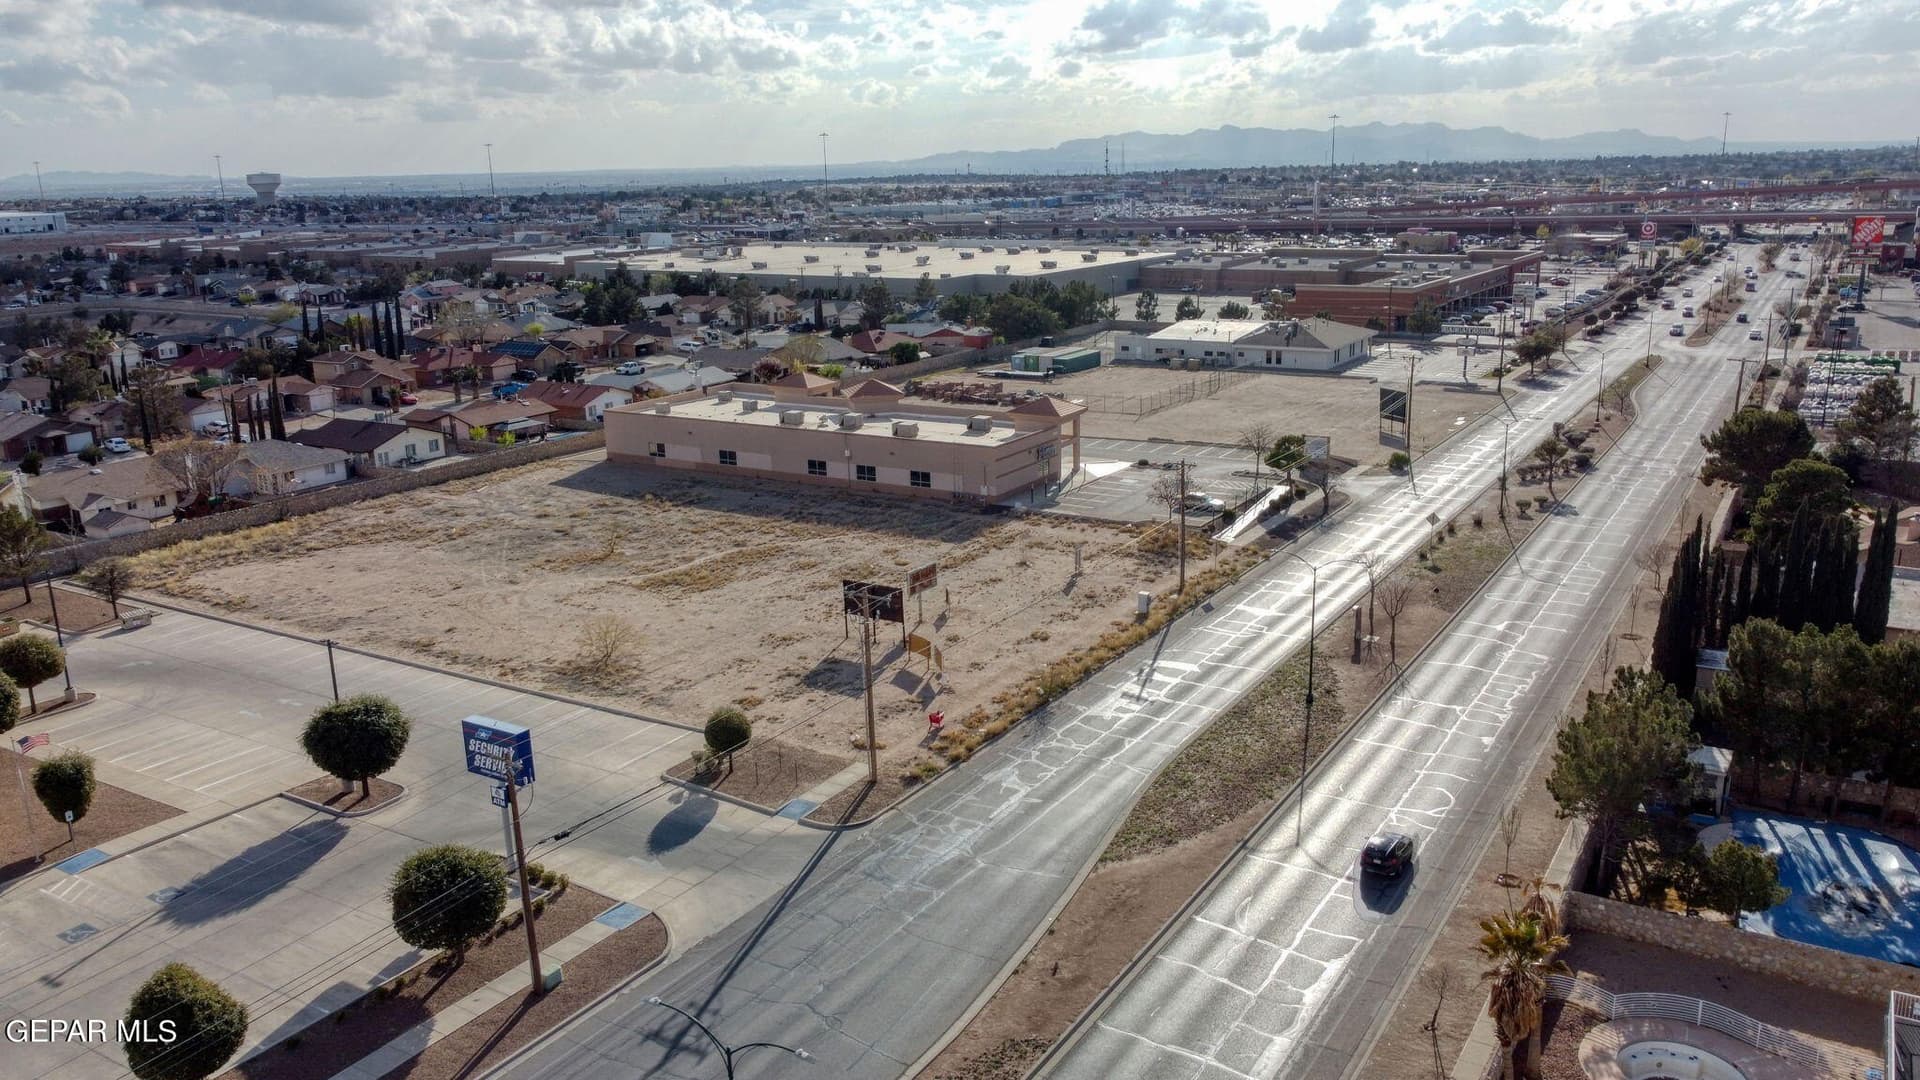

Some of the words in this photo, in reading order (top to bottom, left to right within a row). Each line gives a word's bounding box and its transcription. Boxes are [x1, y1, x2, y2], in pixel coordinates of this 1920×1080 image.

[469, 739, 515, 758] SECURITY
[474, 754, 508, 774] SERVIC
[493, 798, 506, 807] ATM
